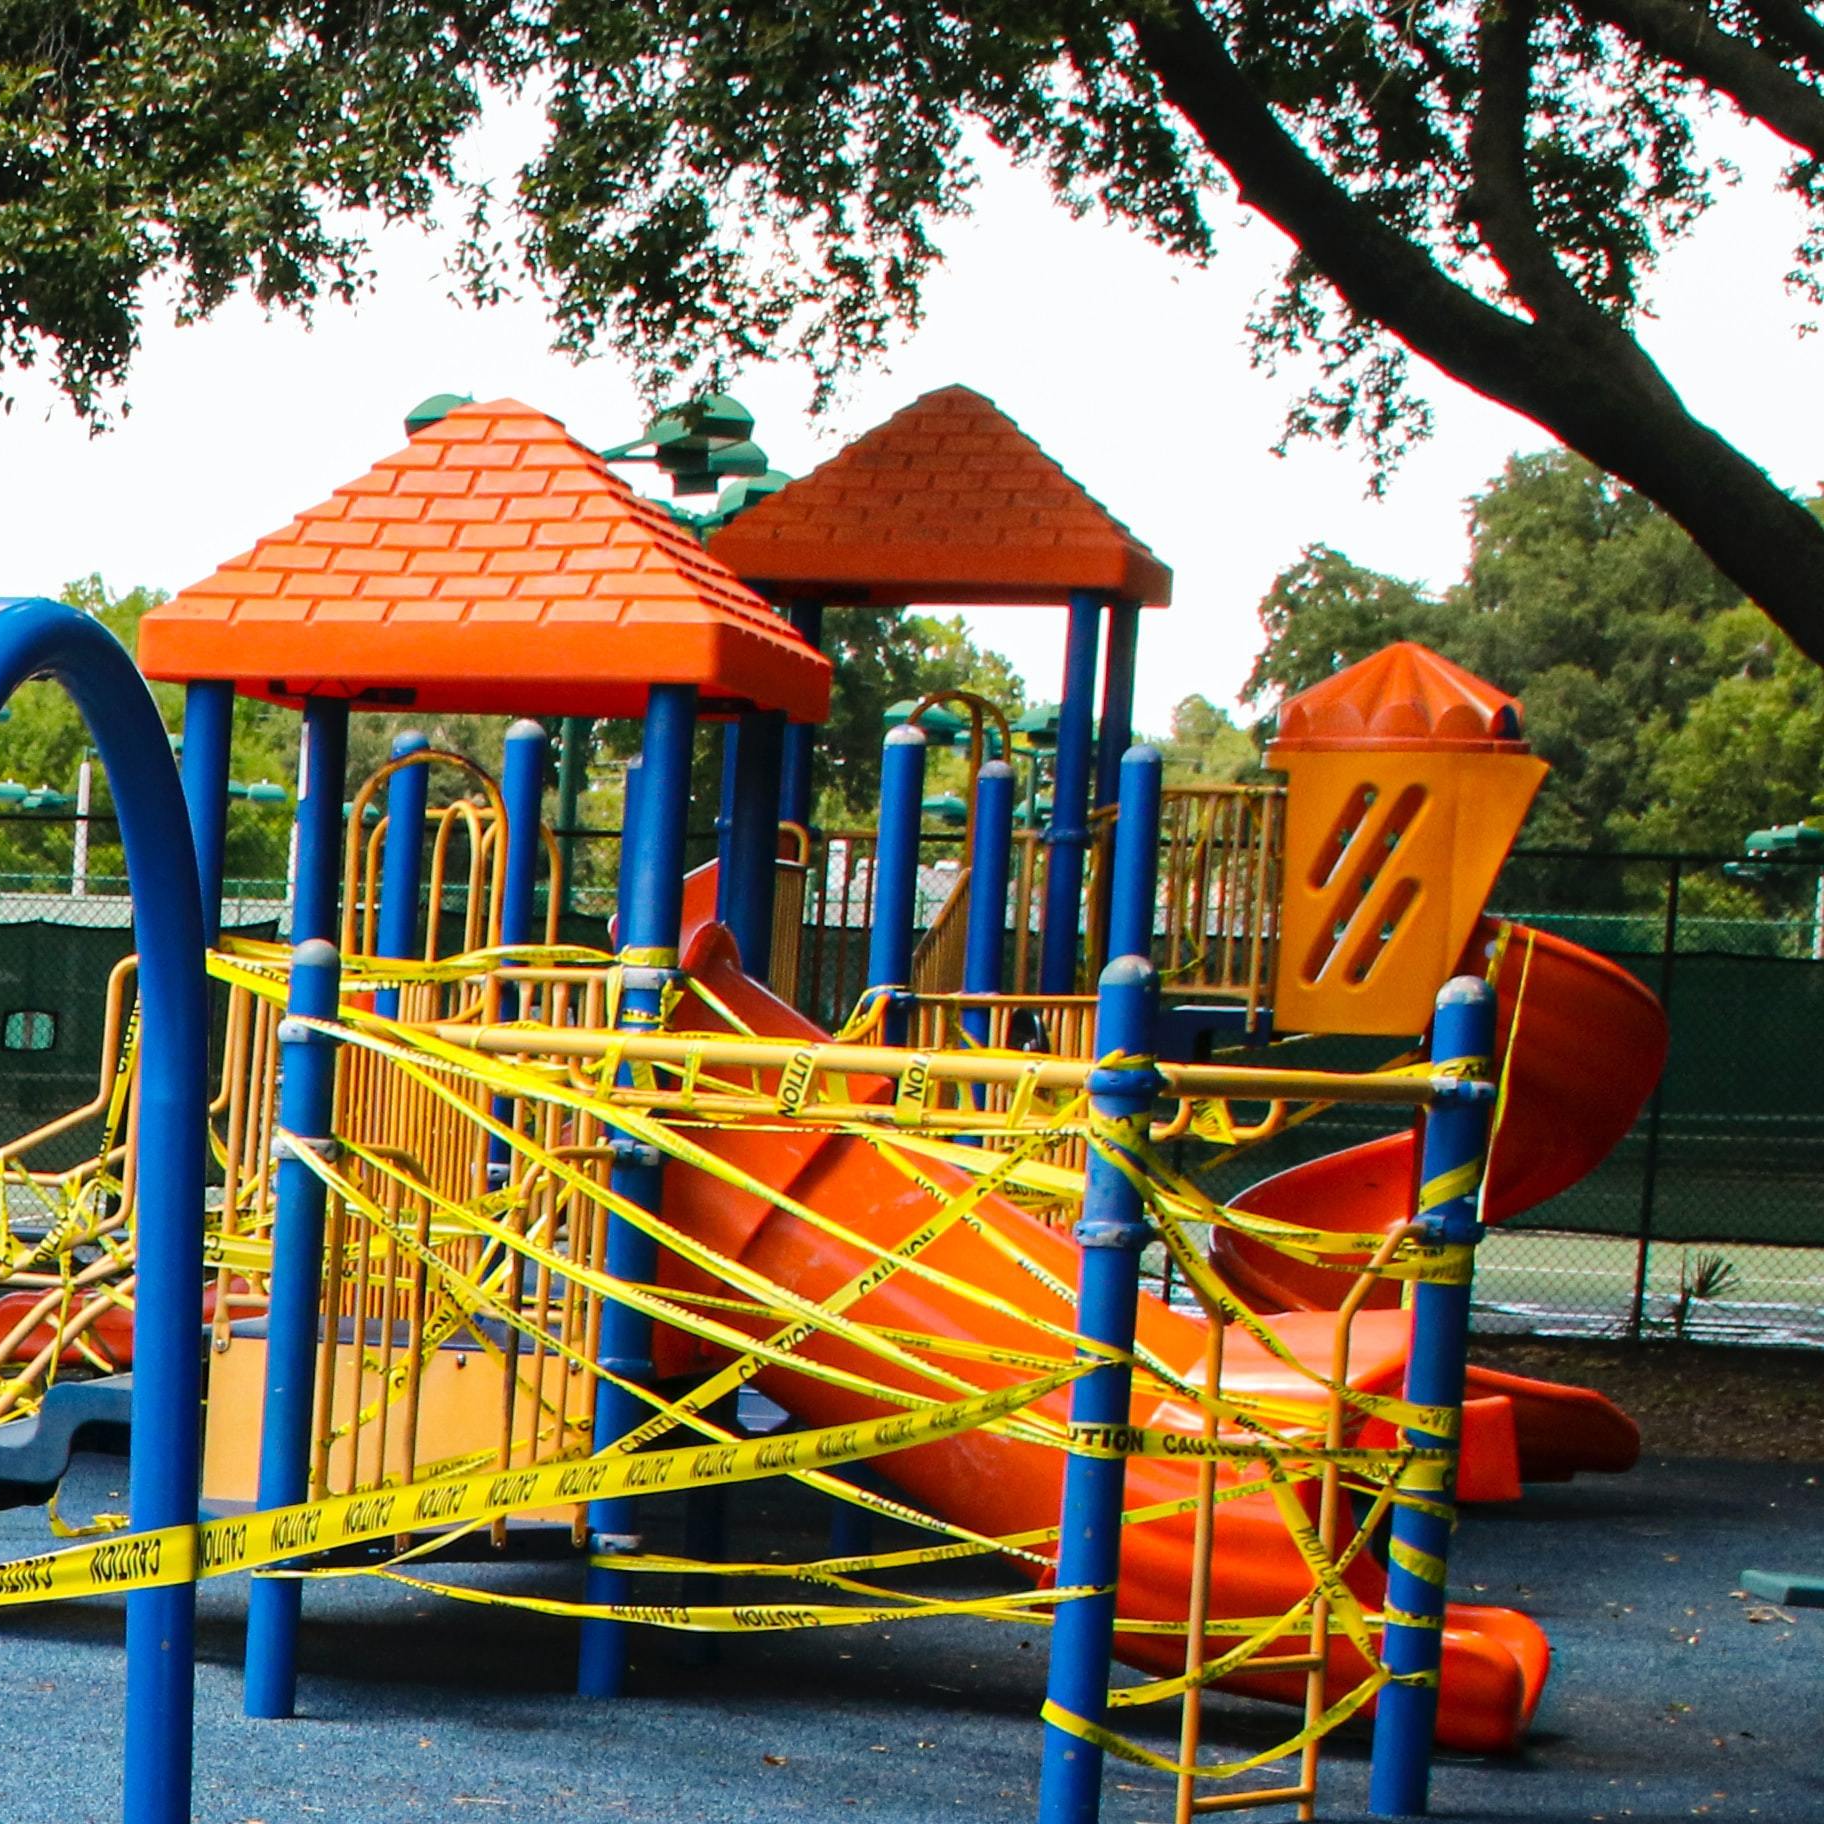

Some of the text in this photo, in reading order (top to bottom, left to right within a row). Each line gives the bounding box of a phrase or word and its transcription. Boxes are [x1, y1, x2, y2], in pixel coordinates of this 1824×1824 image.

[777, 1050, 813, 1118] UTION
[90, 1538, 162, 1584] CAUTION
[270, 1509, 323, 1553] CAUTION
[342, 1495, 396, 1535] CAUTION
[413, 1483, 469, 1521] CAUTION
[484, 1473, 539, 1510] CAUTION
[732, 1606, 822, 1628] CAUTION
